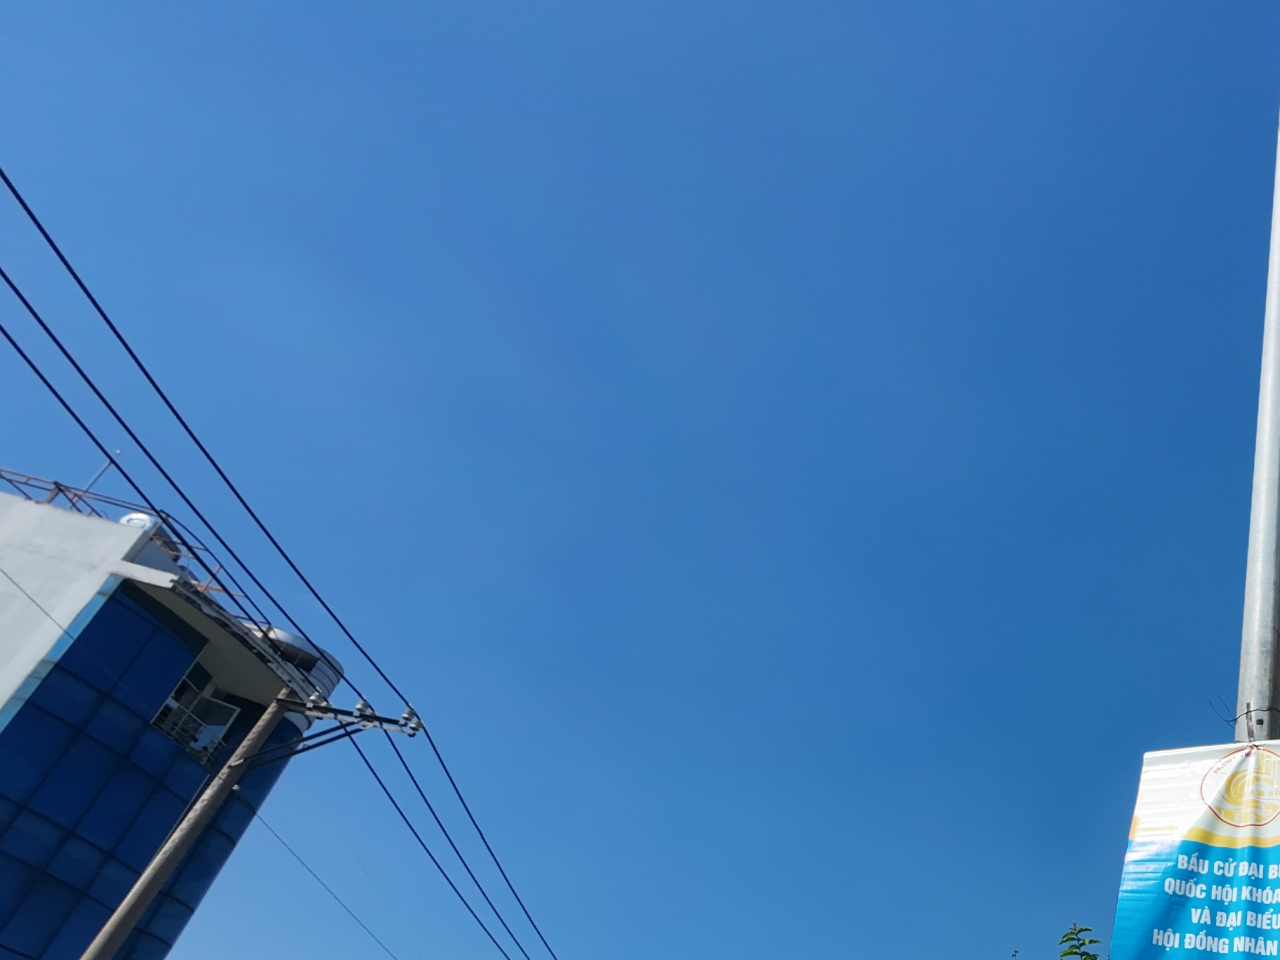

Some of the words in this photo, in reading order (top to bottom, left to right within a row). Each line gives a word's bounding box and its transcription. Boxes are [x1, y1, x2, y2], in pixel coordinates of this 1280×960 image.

[1177, 852, 1209, 874] BẦU
[1213, 858, 1236, 877] CỬ
[1238, 860, 1263, 880] ĐẠI
[1164, 877, 1207, 899] QUỐC
[1211, 884, 1238, 905] HỘI
[1191, 906, 1211, 925] VÀ
[1215, 911, 1242, 931] ĐẠI
[1152, 928, 1179, 951] HỘI
[1184, 929, 1230, 954] ĐỒNG
[1233, 936, 1278, 956] NHÂN
